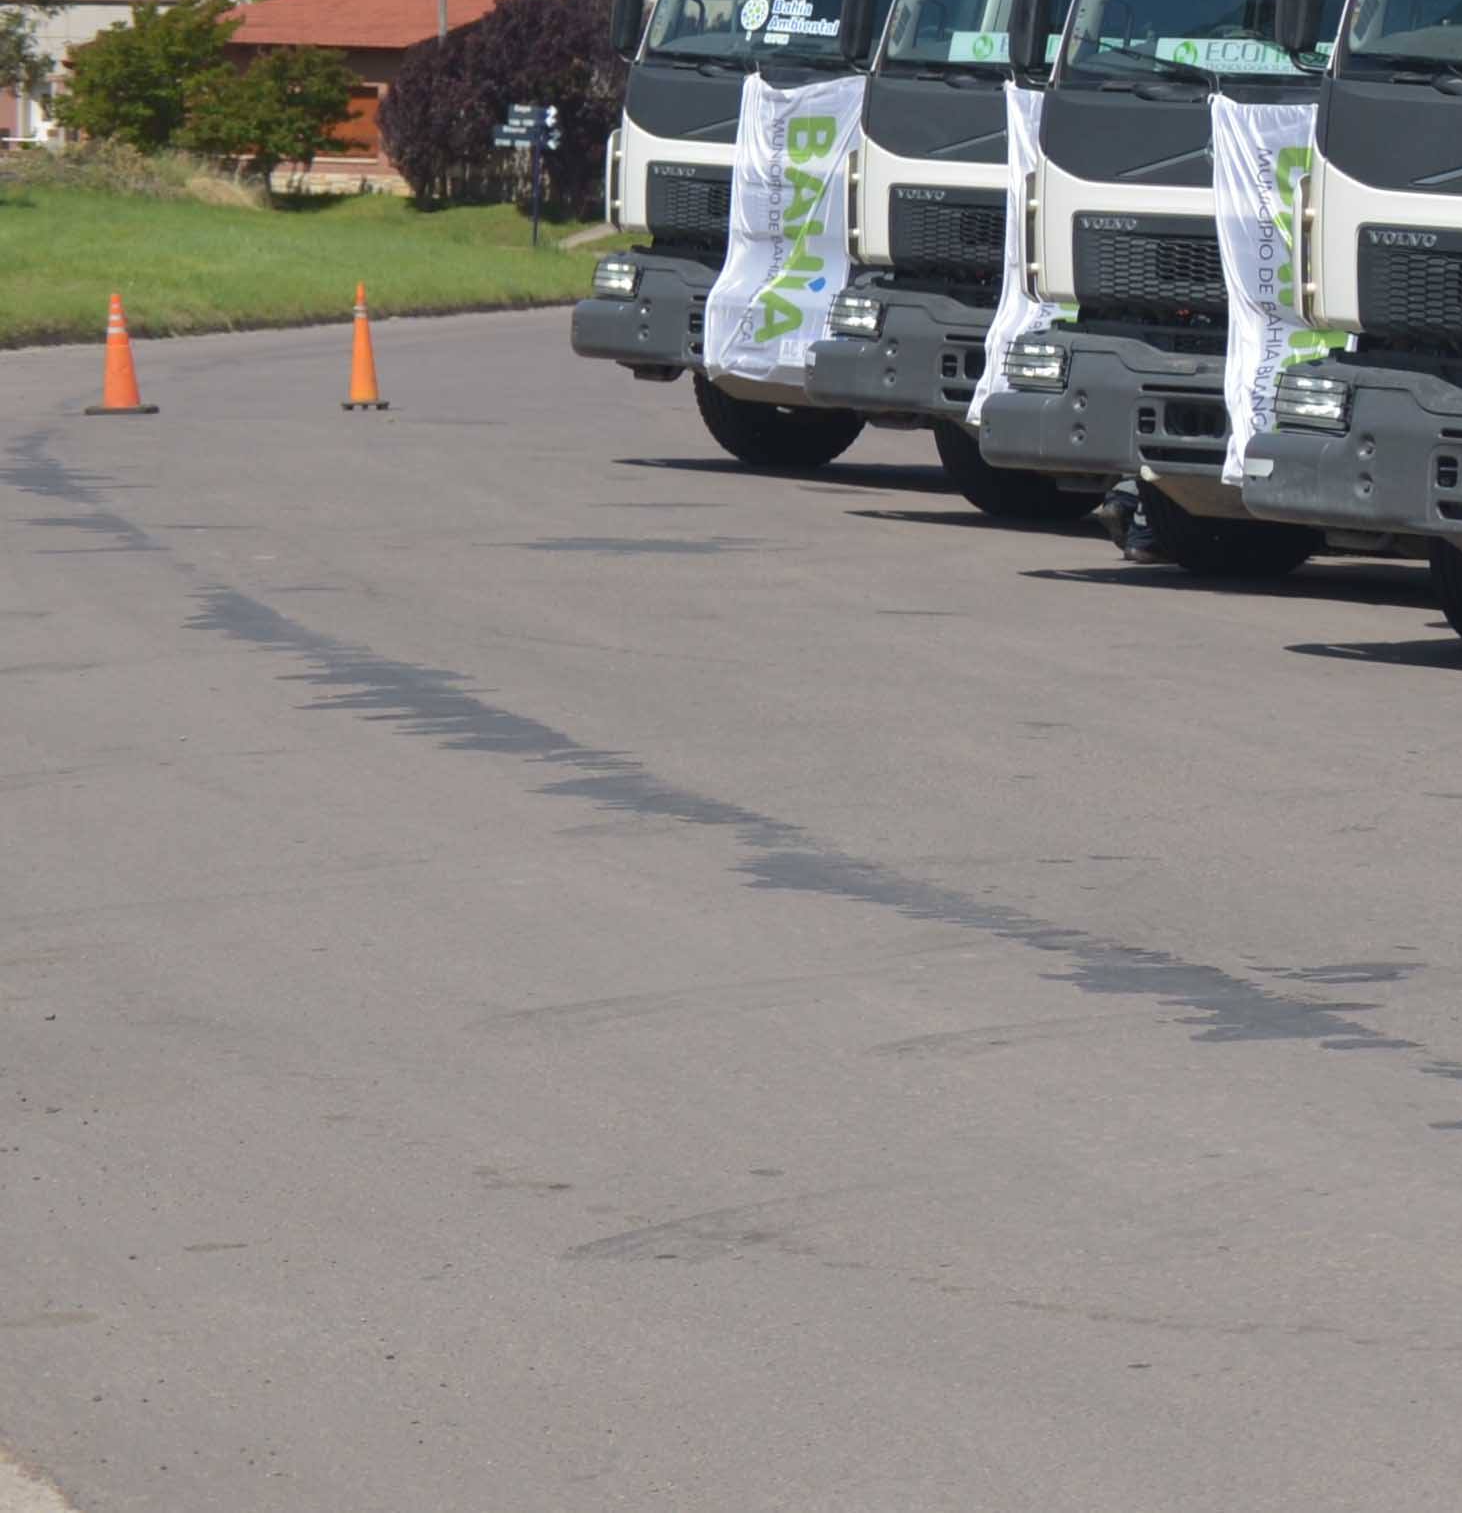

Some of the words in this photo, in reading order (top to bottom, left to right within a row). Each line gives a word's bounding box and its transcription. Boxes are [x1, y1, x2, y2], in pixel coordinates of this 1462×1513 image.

[1080, 217, 1137, 231] VOLVO
[1368, 230, 1437, 248] VOLVO
[1258, 267, 1274, 295] DE
